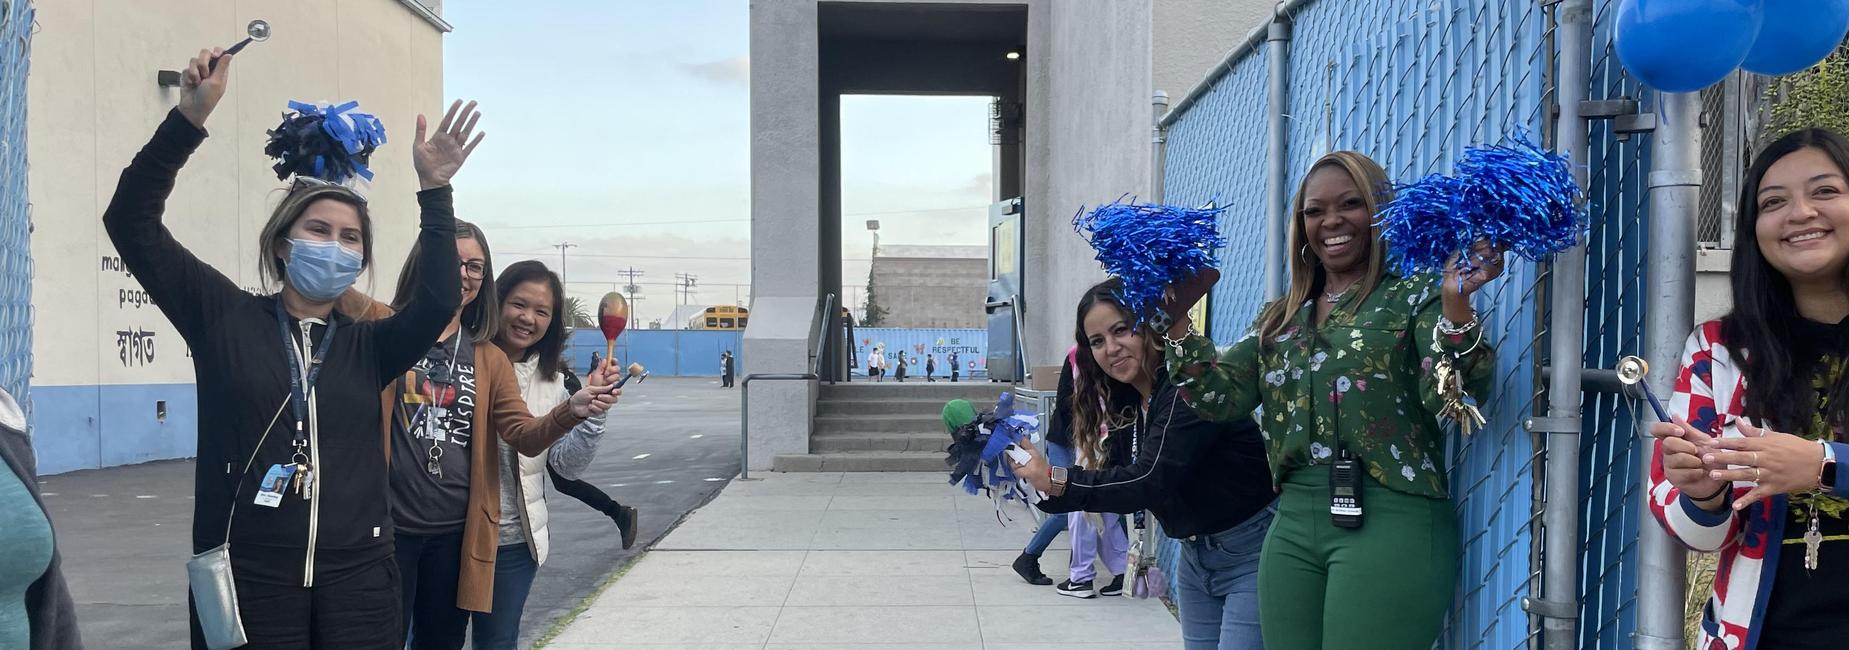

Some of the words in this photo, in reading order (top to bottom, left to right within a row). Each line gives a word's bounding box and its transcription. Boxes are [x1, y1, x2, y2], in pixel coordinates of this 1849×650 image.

[116, 325, 155, 367] স্বাগত
[932, 346, 980, 354] RESPECTFUL
[950, 337, 960, 345] BE
[450, 364, 477, 448] INSPIRE
